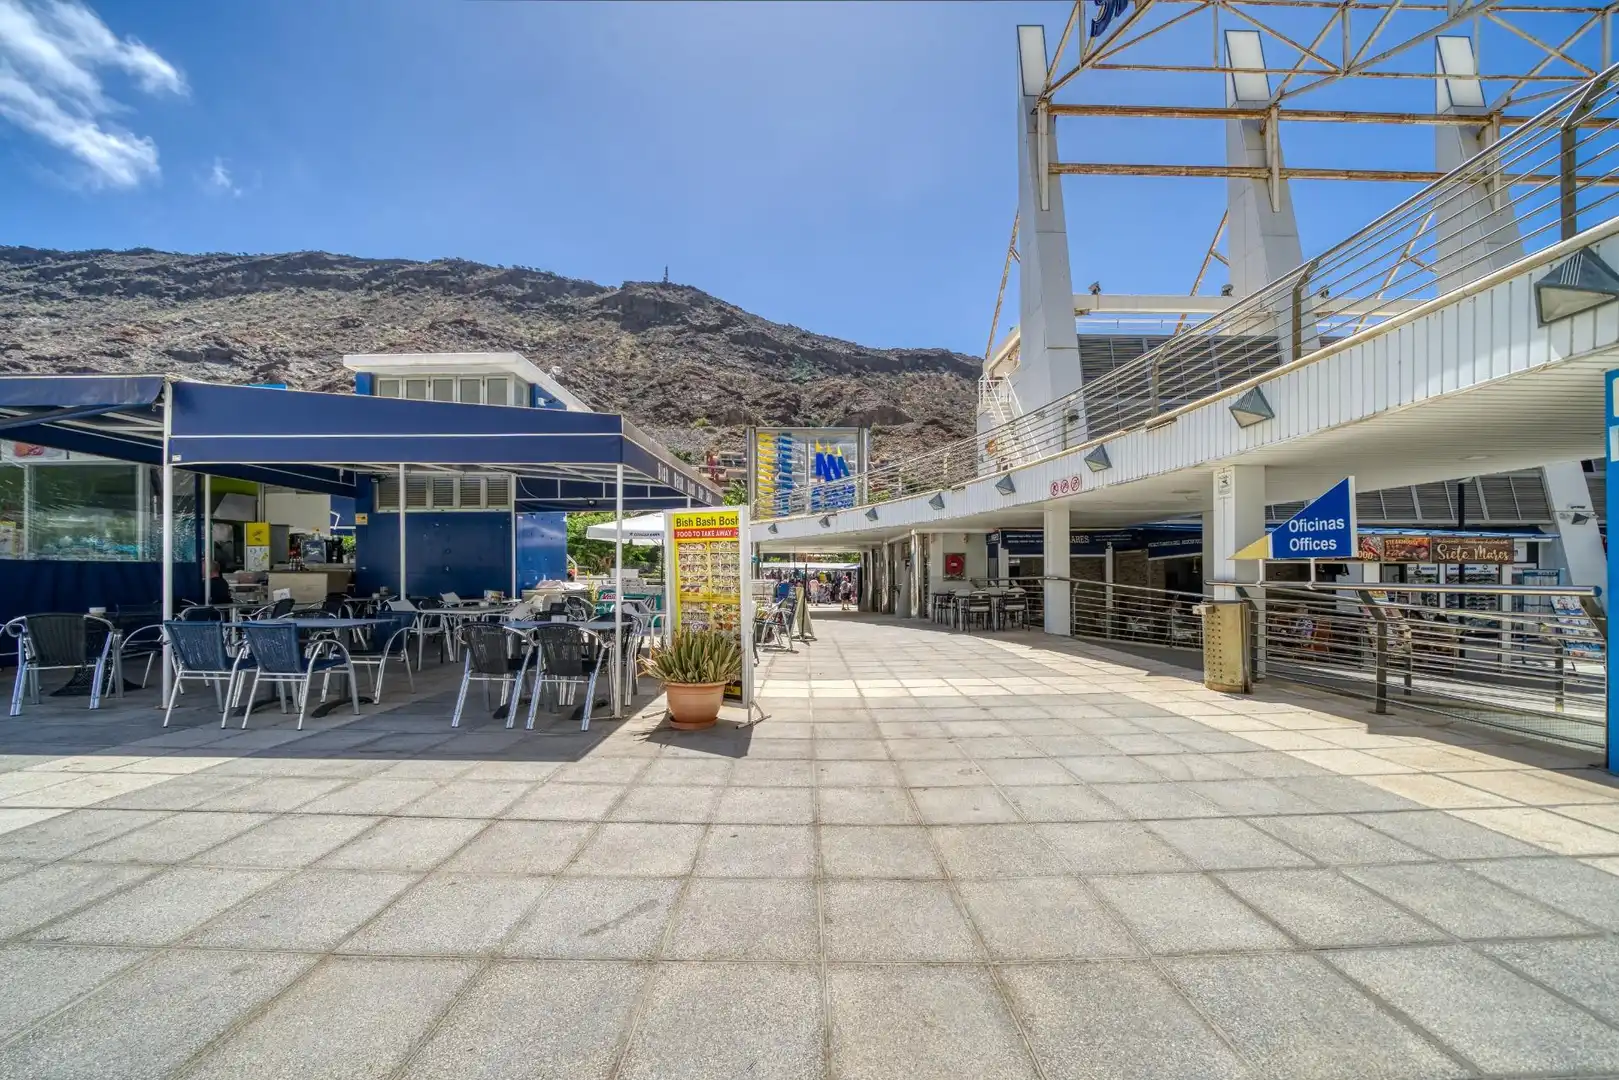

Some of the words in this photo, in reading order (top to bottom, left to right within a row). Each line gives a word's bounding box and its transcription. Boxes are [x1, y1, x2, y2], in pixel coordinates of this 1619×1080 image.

[676, 518, 693, 527] Bish
[696, 516, 716, 526] Bash
[719, 516, 739, 526] Bosh
[1288, 517, 1345, 533] Oficinas
[1070, 535, 1090, 544] ARES
[1289, 537, 1337, 552] Offices
[1437, 543, 1469, 561] Siete
[1474, 545, 1508, 561] Mares
